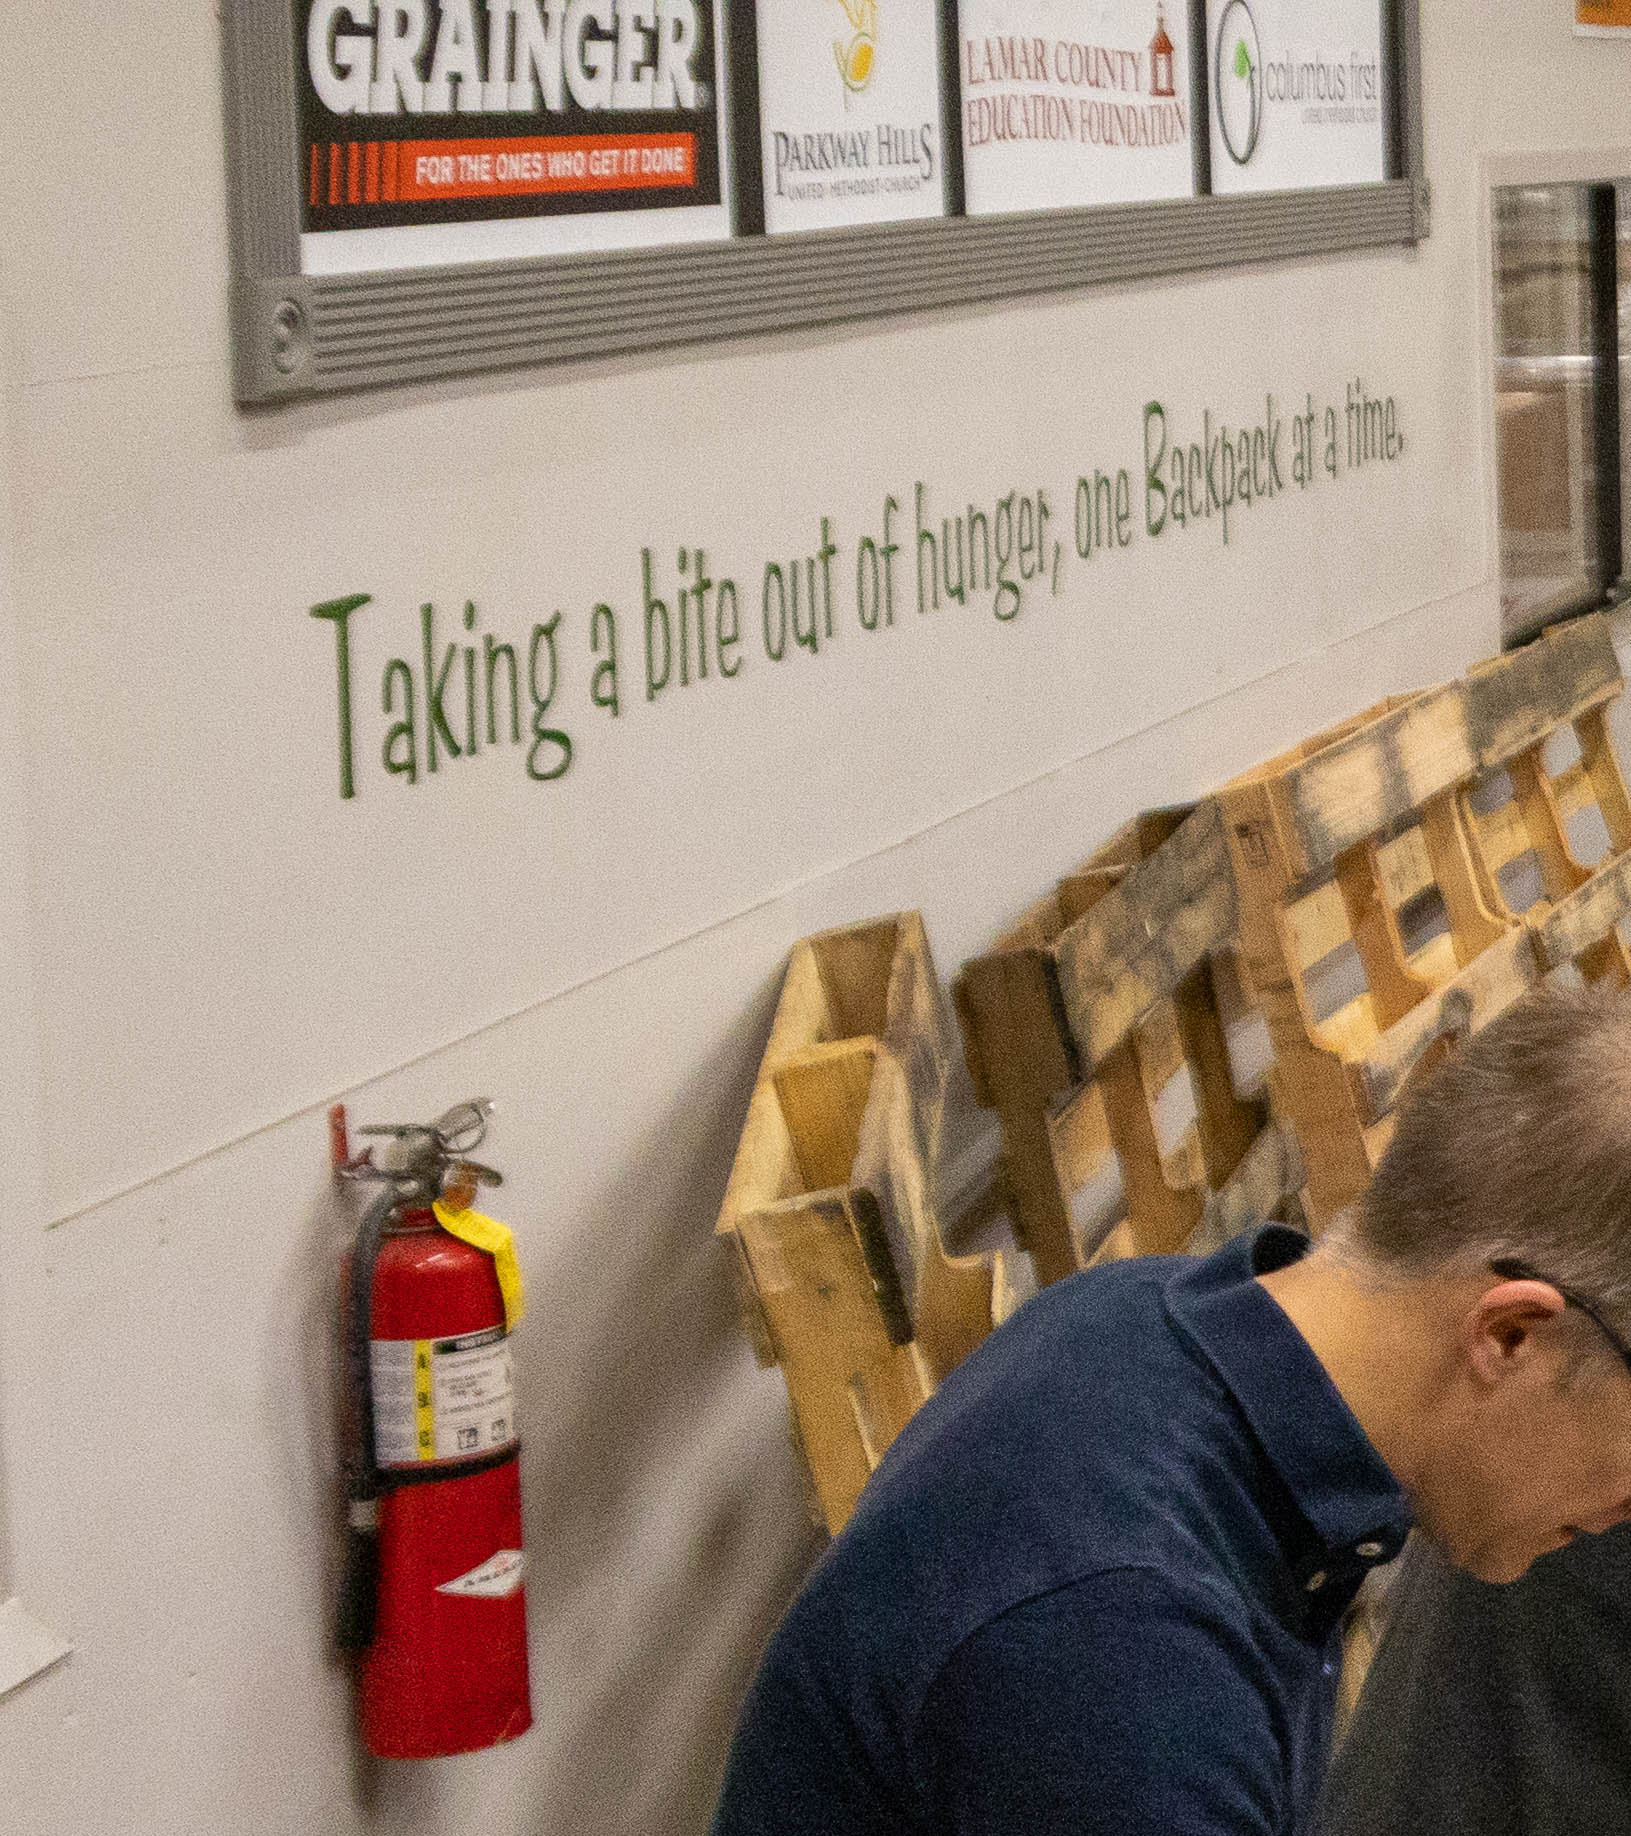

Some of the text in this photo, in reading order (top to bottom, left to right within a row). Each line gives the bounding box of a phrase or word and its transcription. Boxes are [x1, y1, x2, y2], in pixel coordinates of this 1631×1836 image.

[307, 0, 700, 115] GRAINGER
[966, 36, 1144, 93] LAMAR COUNTY
[1266, 48, 1377, 101] columbus first
[966, 93, 1186, 147] EDUCATION FOUNDATION
[415, 146, 686, 185] FOR THE ONES WHO GET IT DONE
[773, 123, 934, 196] PARKWAY HILLS
[309, 376, 1404, 800] Taking a bite out of hunger, one Backpack at a time.
